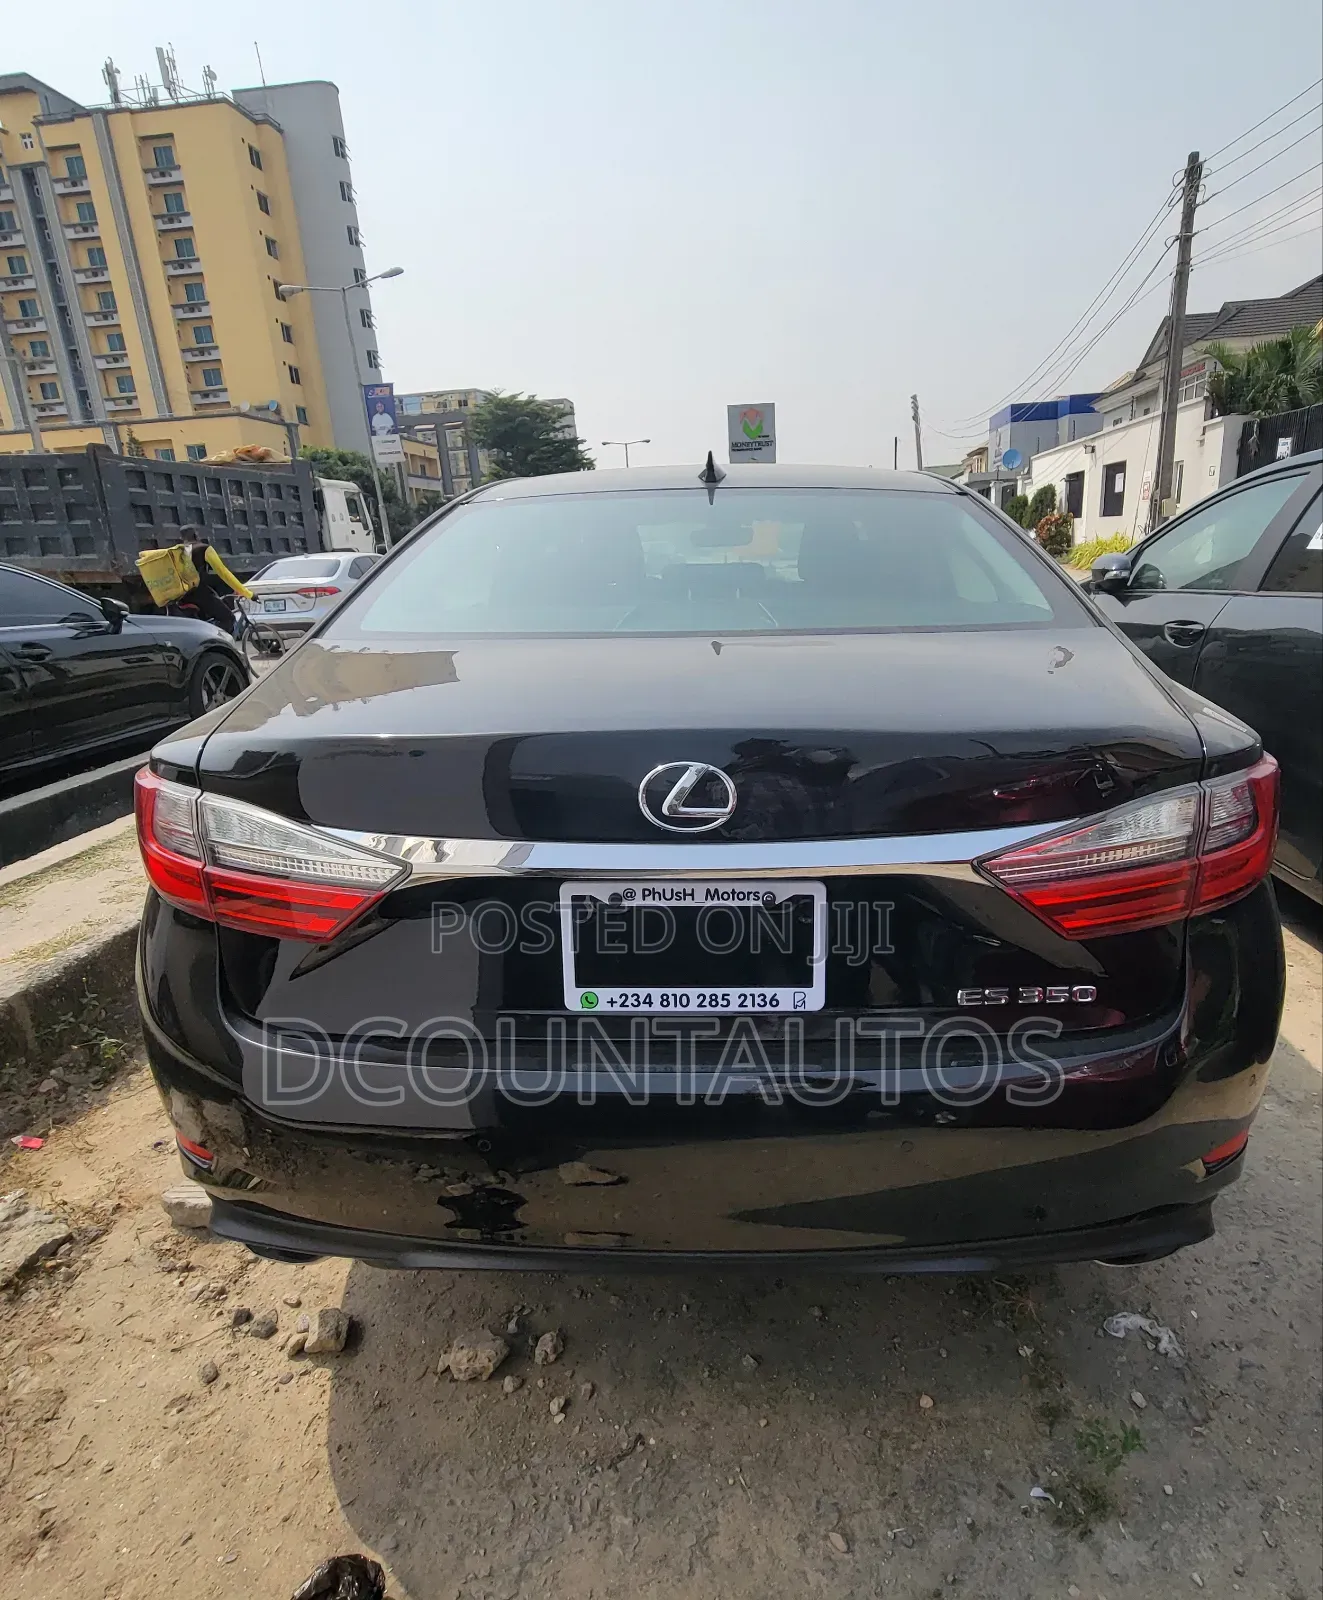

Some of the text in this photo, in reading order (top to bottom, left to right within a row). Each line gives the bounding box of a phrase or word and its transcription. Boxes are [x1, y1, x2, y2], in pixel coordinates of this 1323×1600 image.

[731, 440, 774, 448] MONEYTRUST
[641, 887, 761, 904] PhUsH_Motors
[606, 992, 654, 1009] +234
[659, 992, 691, 1009] 810
[696, 992, 731, 1009] 285
[737, 992, 780, 1009] 2136
[957, 985, 1097, 1006] ES 350
